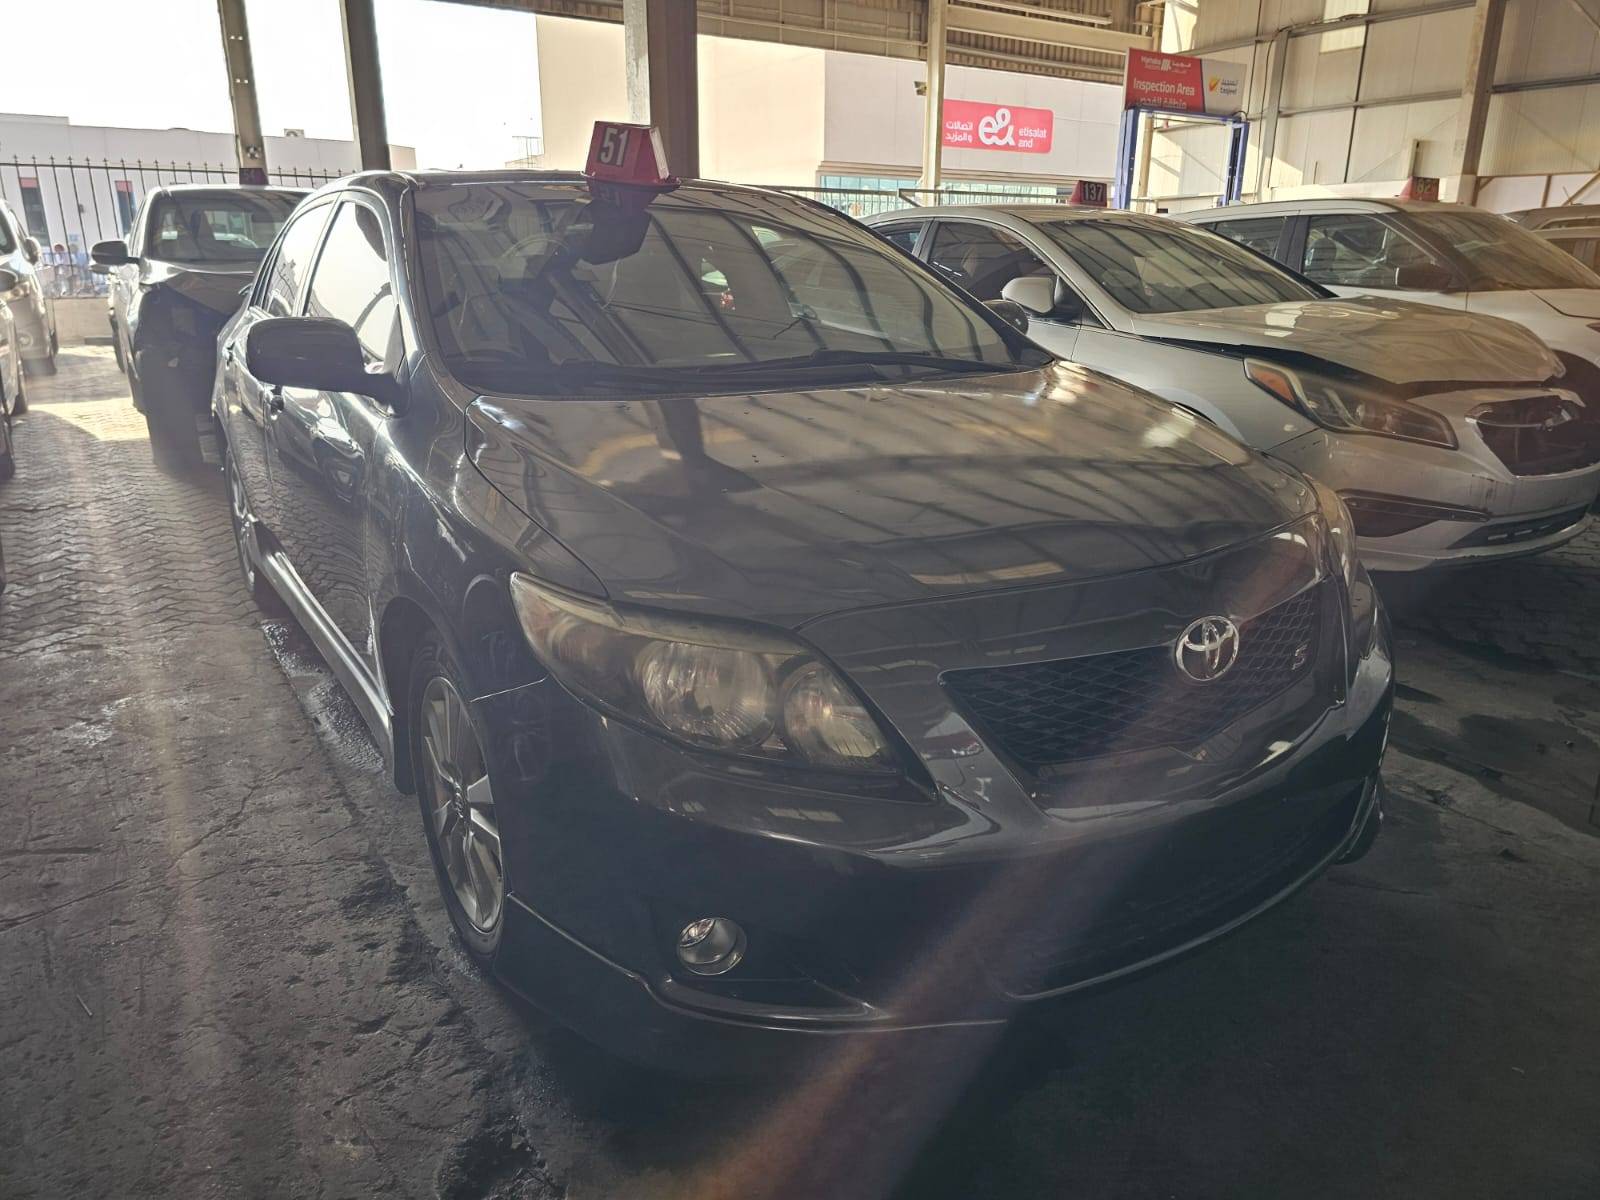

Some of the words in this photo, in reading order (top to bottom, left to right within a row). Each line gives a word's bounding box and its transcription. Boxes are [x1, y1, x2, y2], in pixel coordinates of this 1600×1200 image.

[1133, 77, 1175, 94] Inspection
[1176, 82, 1195, 96] Area
[946, 120, 973, 131] اتصالات
[945, 132, 973, 143] والمزيد
[1018, 127, 1047, 139] etisalat
[600, 127, 629, 166] 51
[1018, 139, 1033, 148] and
[1084, 182, 1104, 202] 137
